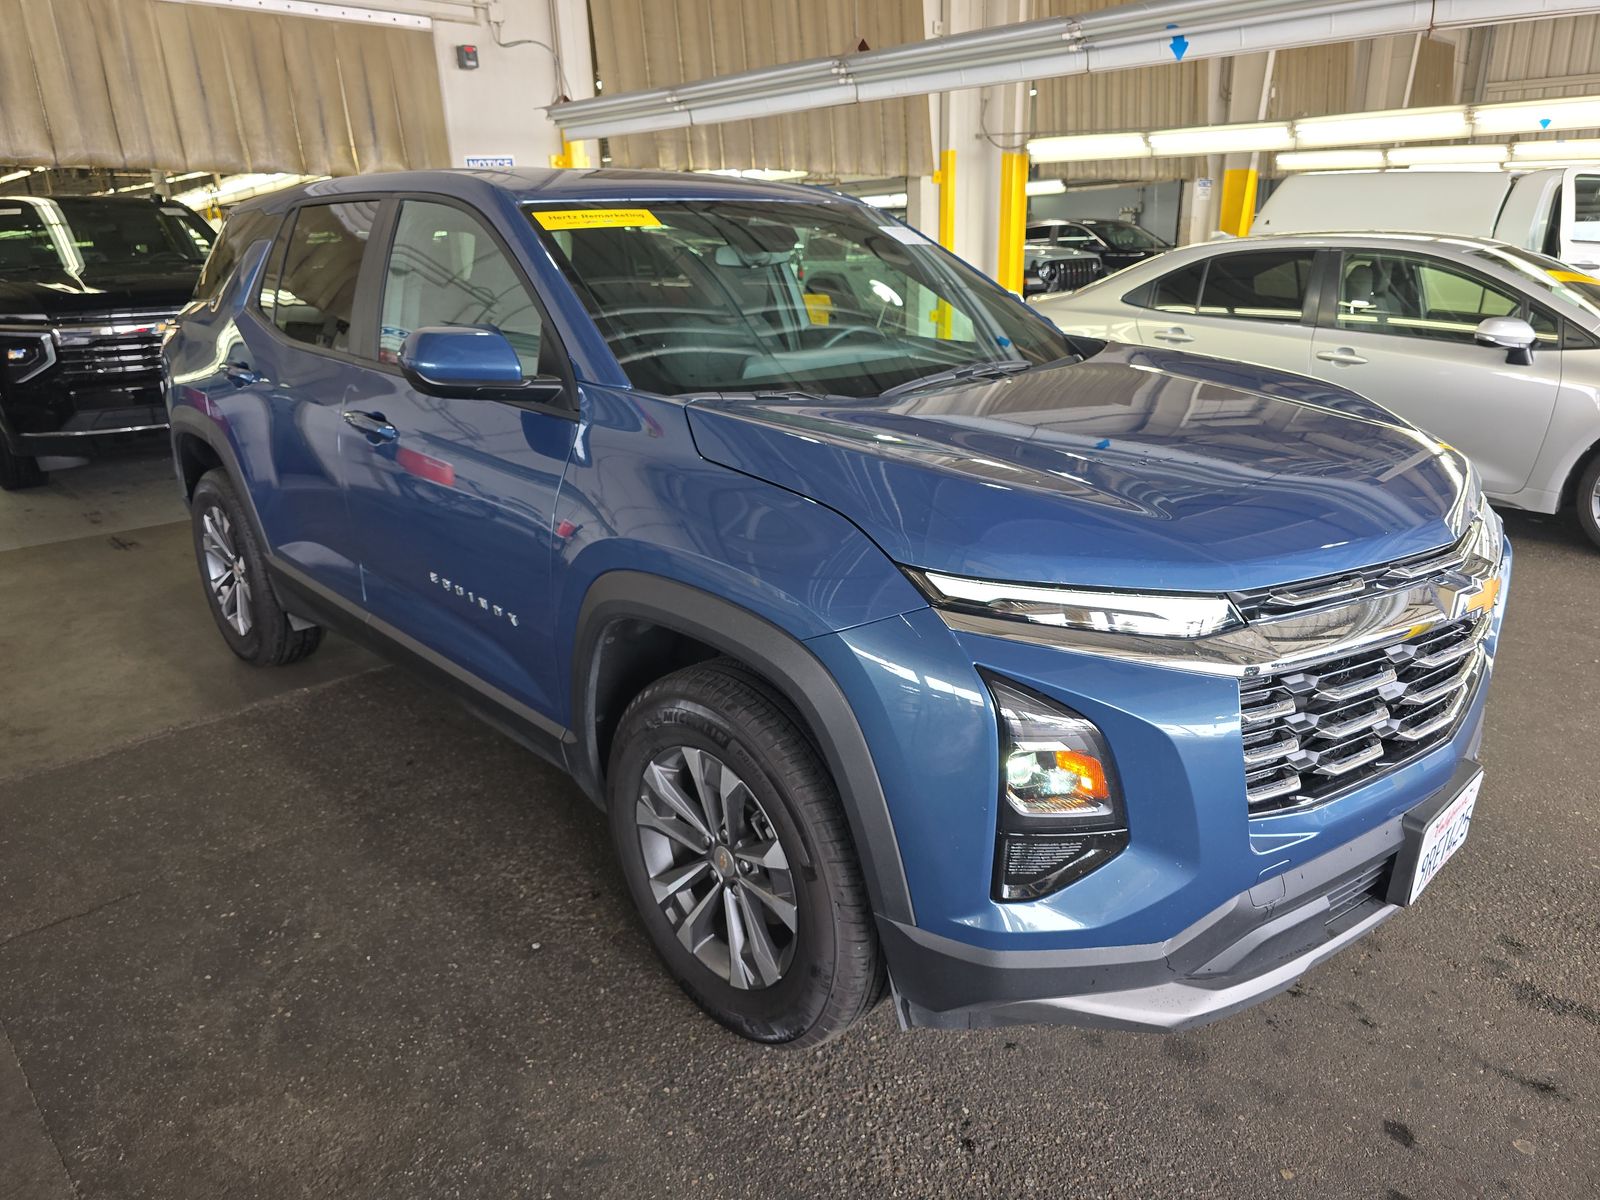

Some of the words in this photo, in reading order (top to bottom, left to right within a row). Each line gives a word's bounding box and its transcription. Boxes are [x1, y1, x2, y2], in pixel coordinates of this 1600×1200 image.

[468, 159, 512, 168] NOTICE
[580, 212, 646, 220] Remarketing
[429, 571, 519, 627] EQUINOX
